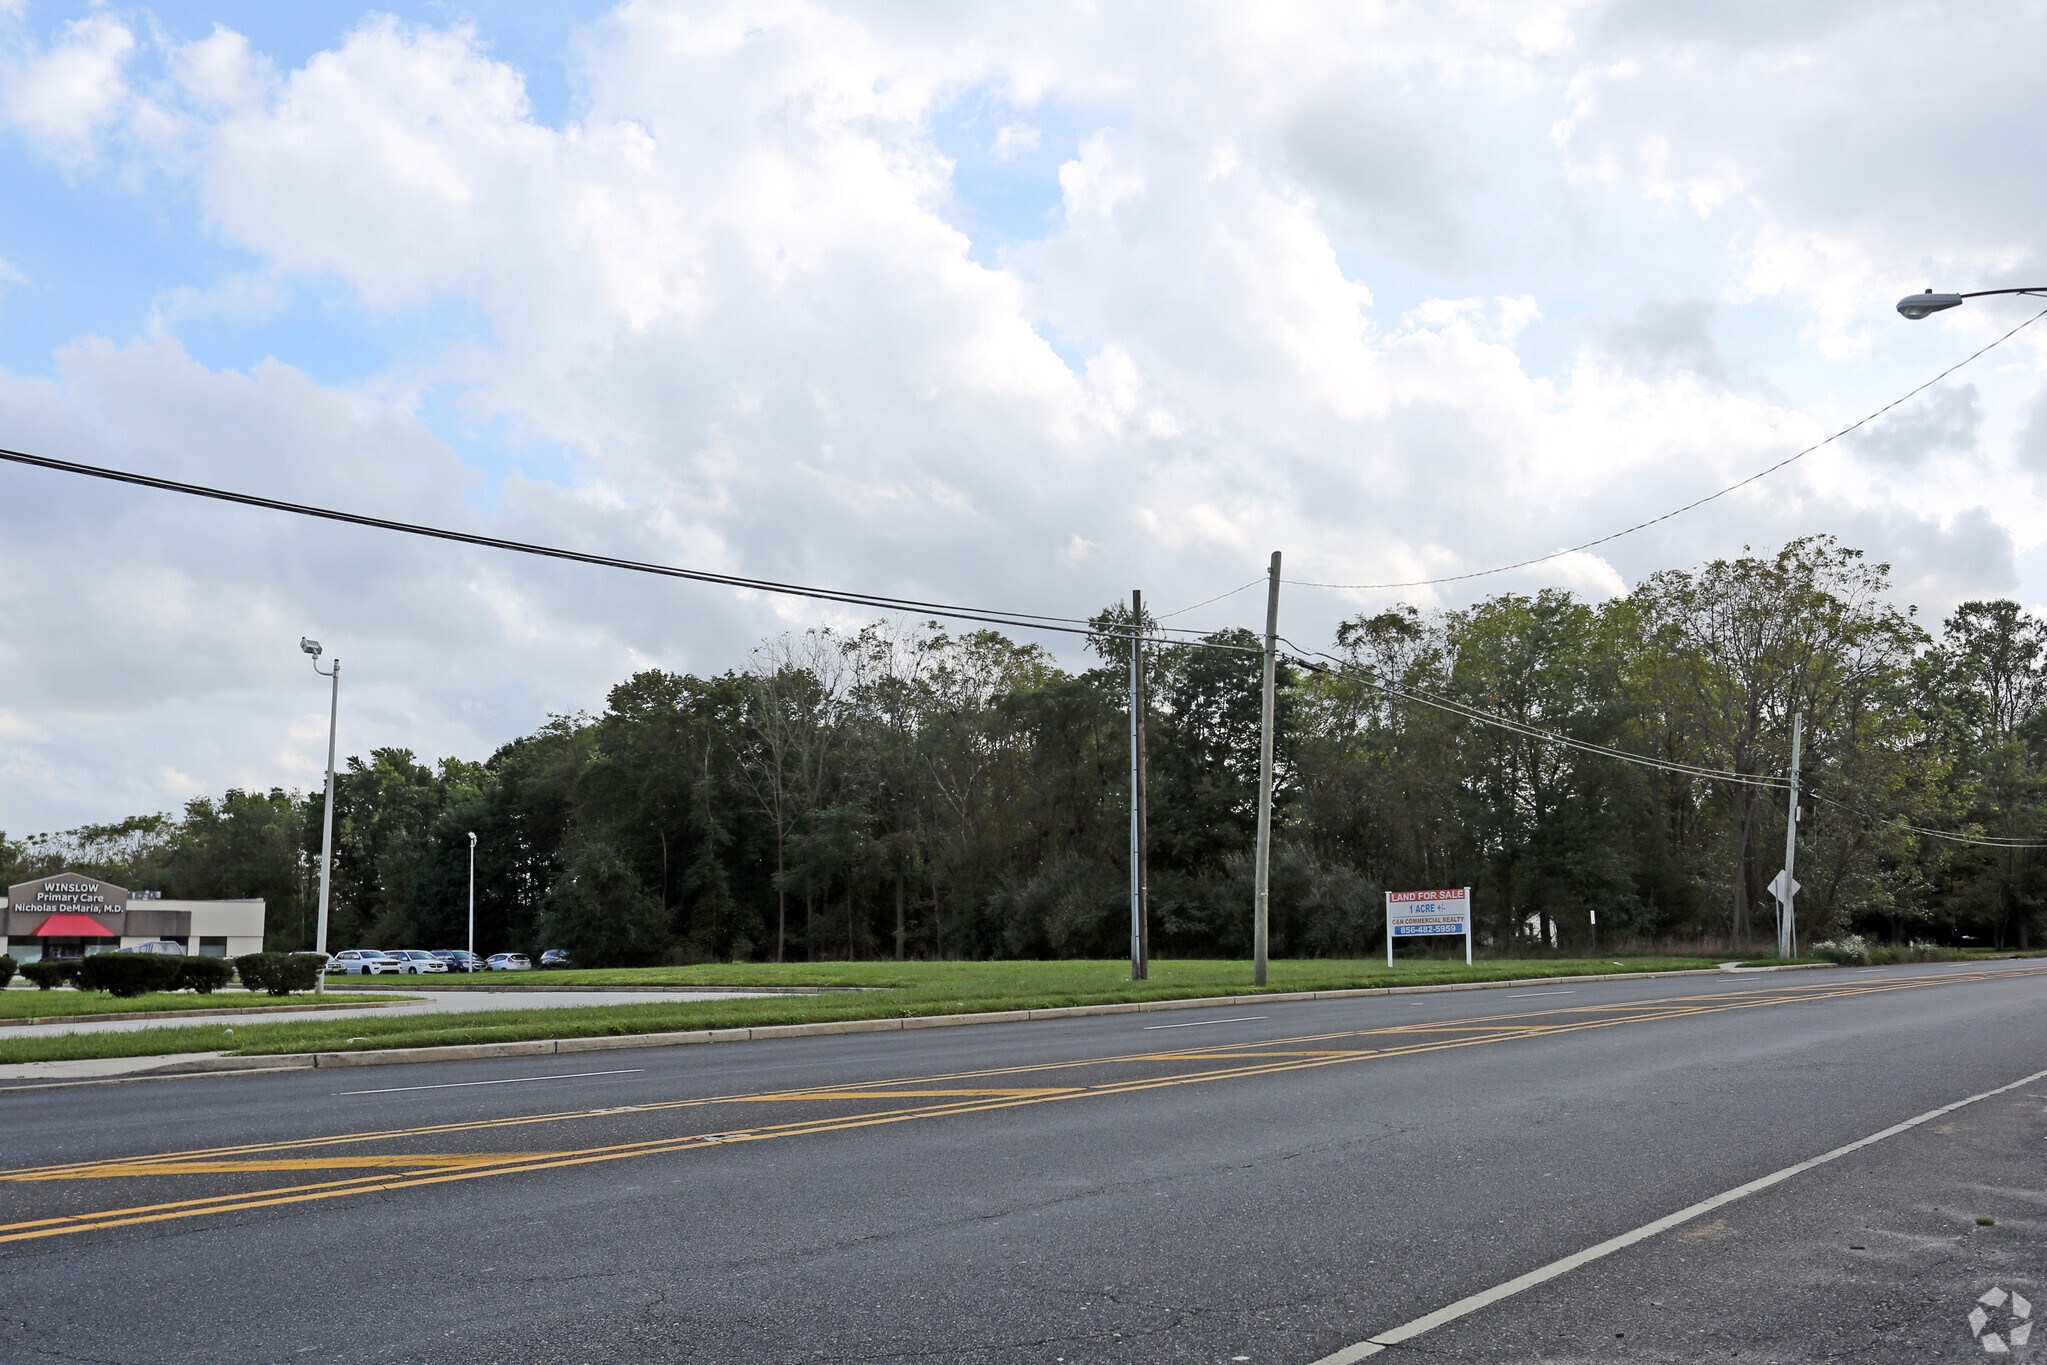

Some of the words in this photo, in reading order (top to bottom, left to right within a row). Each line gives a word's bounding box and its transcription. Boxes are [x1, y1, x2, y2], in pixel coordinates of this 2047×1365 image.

[44, 883, 98, 892] WINSLOW
[37, 893, 78, 903] Primary
[80, 894, 104, 902] Care
[1440, 890, 1464, 898] SALE
[14, 903, 57, 912] Nicholas
[59, 904, 102, 913] DeMaria,
[104, 904, 123, 912] M.D.
[1410, 905, 1413, 913] 1
[1416, 904, 1435, 913] ACRE
[1401, 925, 1456, 933] 856-482-5959
